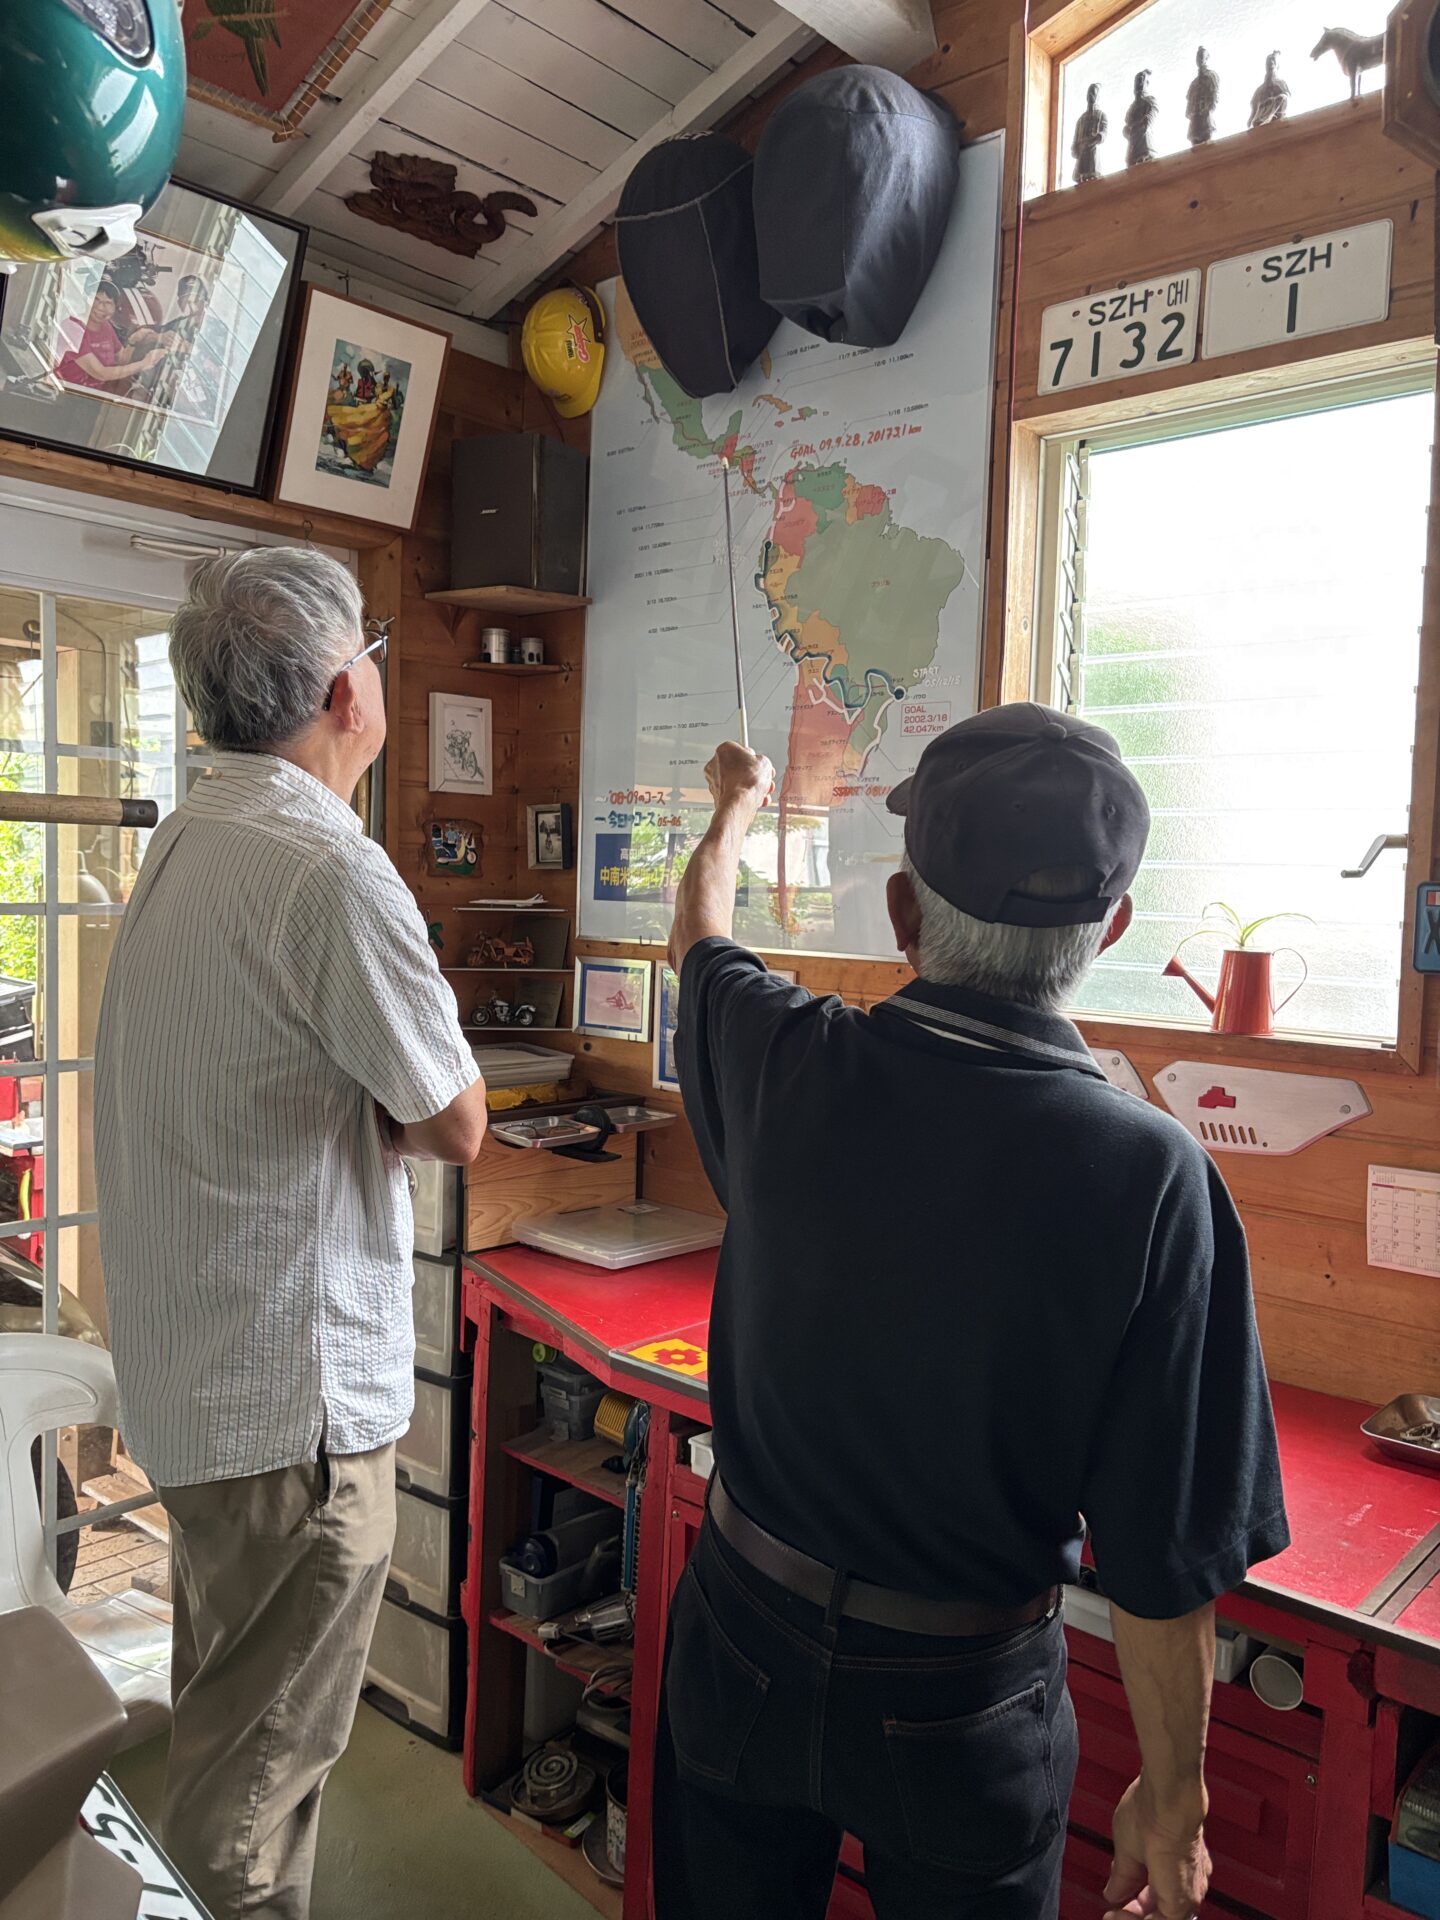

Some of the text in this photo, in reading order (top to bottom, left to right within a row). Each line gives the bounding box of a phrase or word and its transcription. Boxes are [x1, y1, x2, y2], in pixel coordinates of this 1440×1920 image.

[1261, 243, 1333, 284] SZH
[1088, 279, 1190, 326] SZH CHI
[1050, 312, 1186, 387] 7132
[904, 705, 927, 714] GOAL
